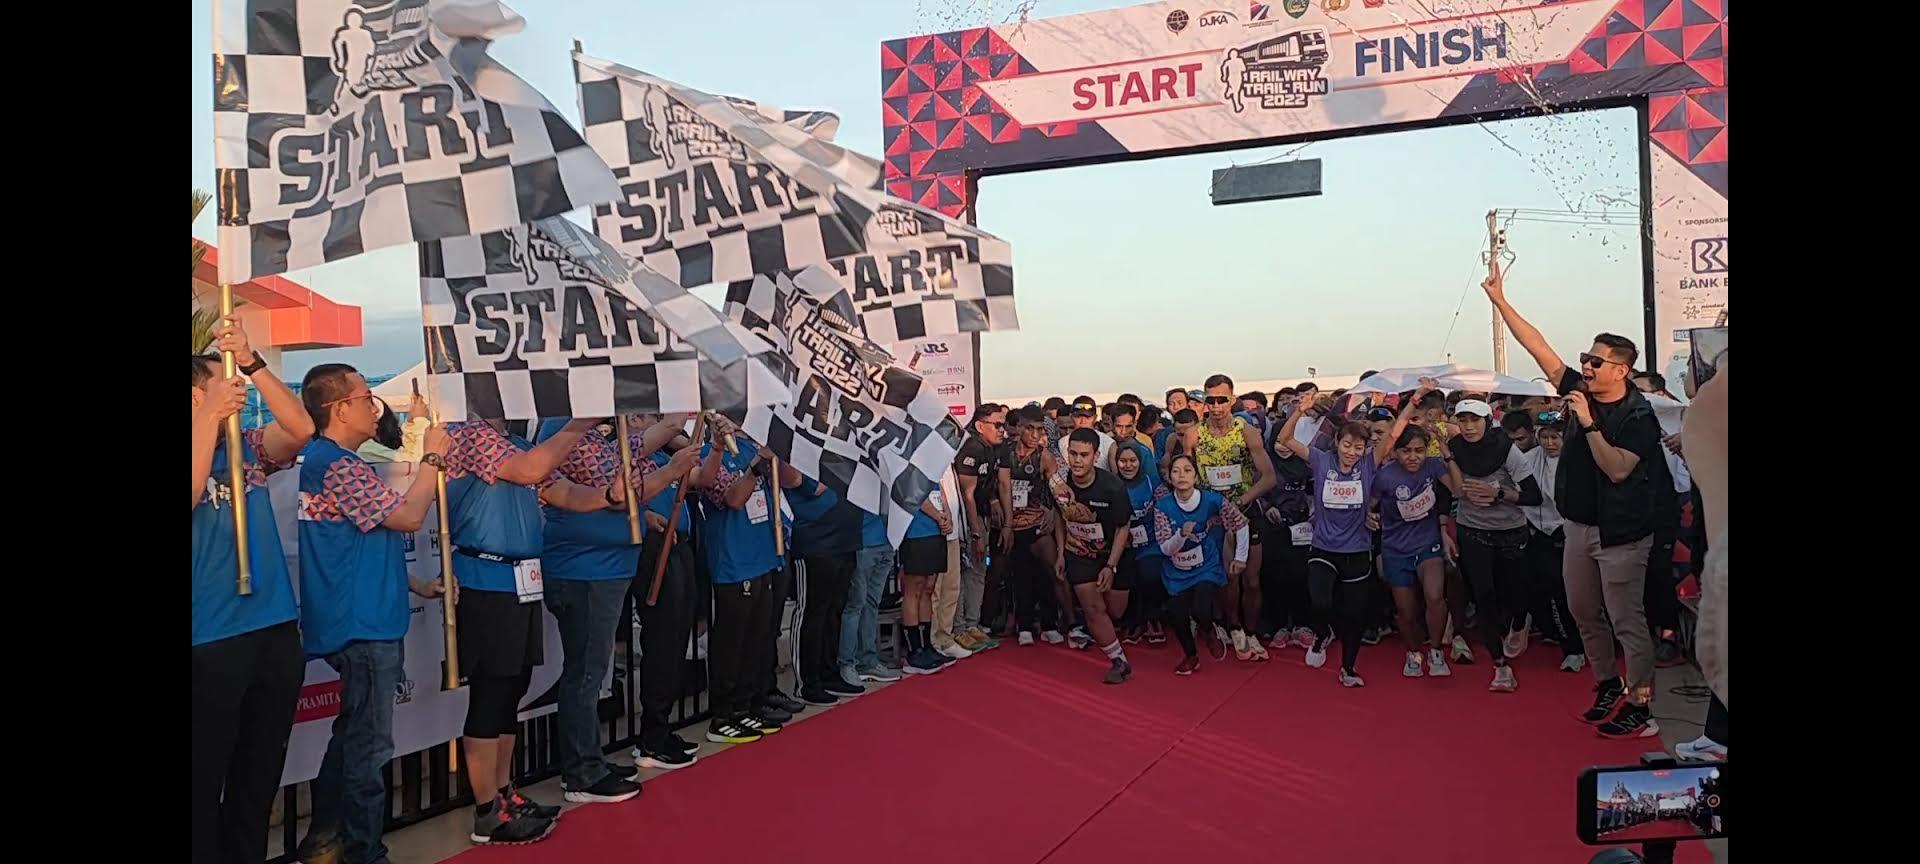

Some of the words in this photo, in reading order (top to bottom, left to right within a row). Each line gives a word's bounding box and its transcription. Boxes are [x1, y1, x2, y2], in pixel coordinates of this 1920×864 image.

[1199, 16, 1229, 28] DJKA
[1354, 22, 1507, 76] FINISH
[1249, 68, 1319, 83] RAILWAY
[1071, 63, 1203, 111] START
[1263, 93, 1306, 107] 2022
[1679, 278, 1720, 290] BANK
[474, 285, 688, 356] STAR
[812, 353, 862, 398] 2022
[1332, 487, 1357, 497] 2089
[477, 552, 504, 562] 2XU
[296, 692, 342, 711] PRAMITA
